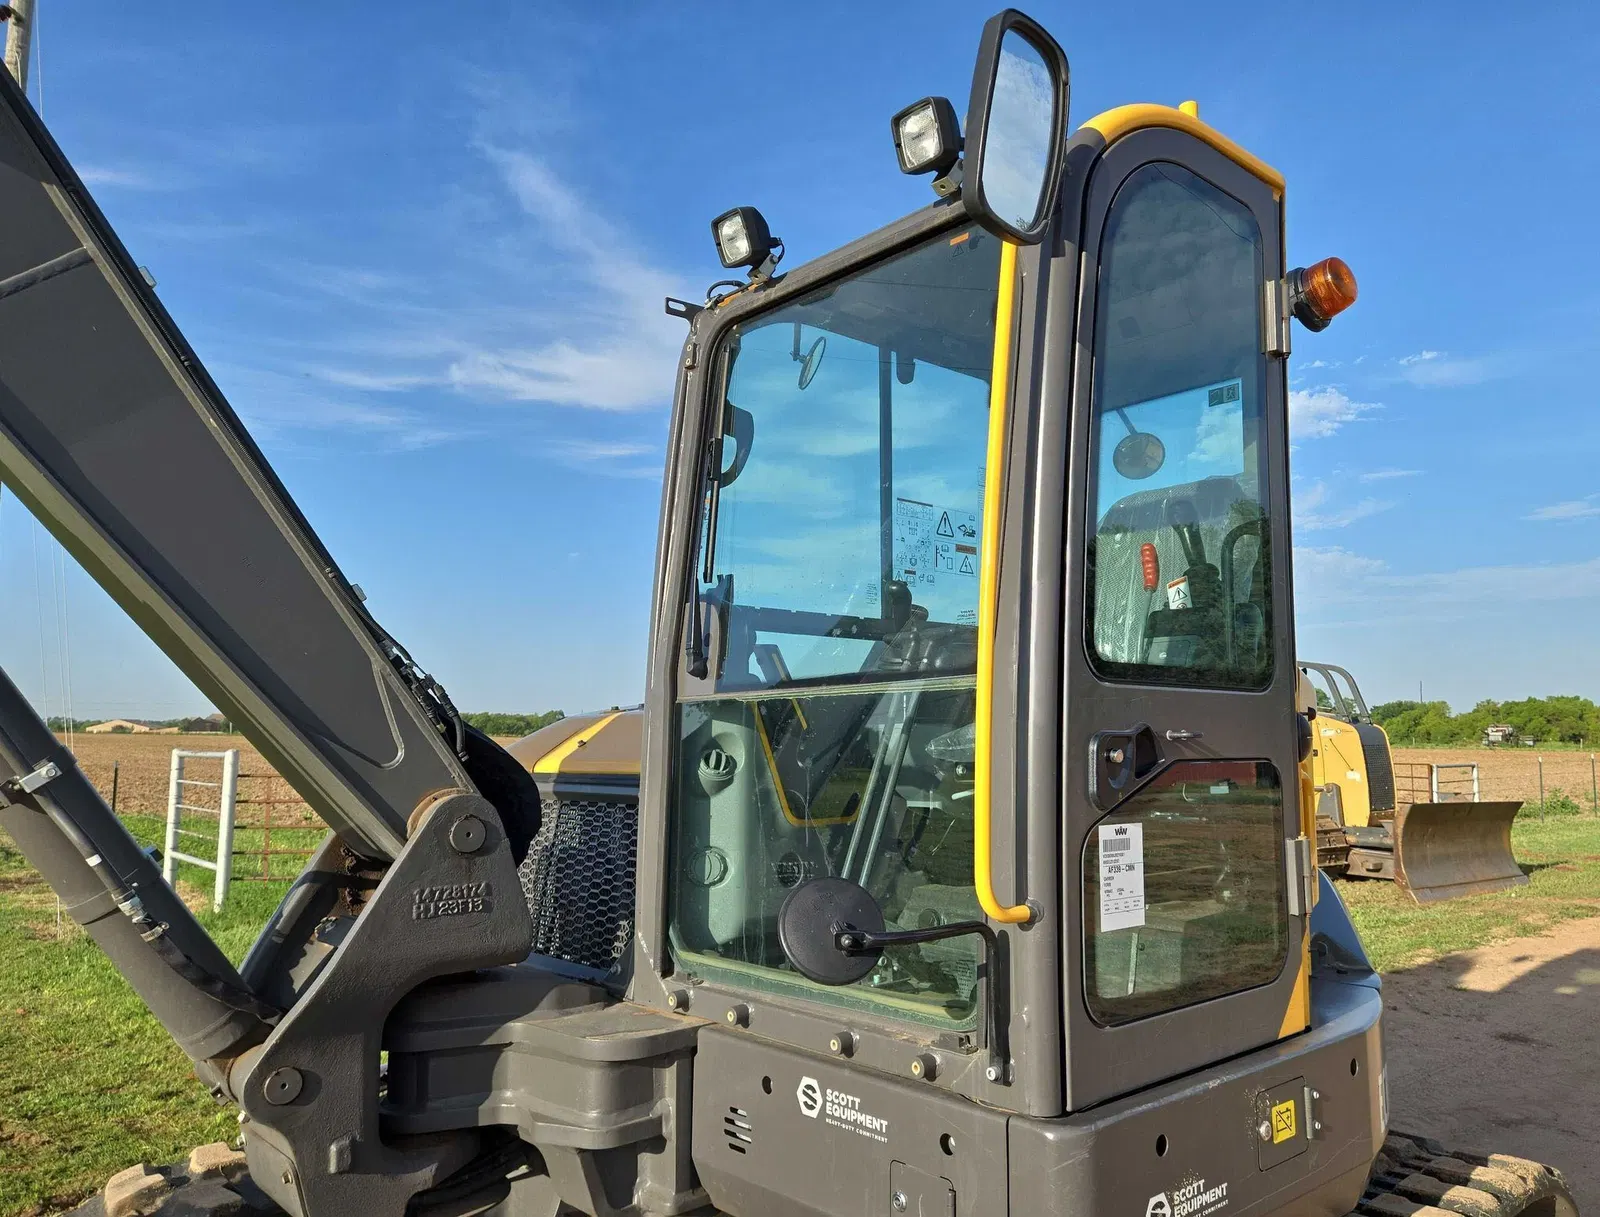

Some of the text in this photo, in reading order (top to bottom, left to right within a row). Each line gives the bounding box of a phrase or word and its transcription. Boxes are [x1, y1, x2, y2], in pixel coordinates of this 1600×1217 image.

[826, 1088, 861, 1110] SCOTT
[826, 1102, 888, 1133] EQUIPMENT
[826, 1117, 888, 1144] HEAVY-DUTY COMMITMENT
[1173, 1179, 1205, 1205] SCOTT
[1174, 1182, 1228, 1217] EQUIPMENT
